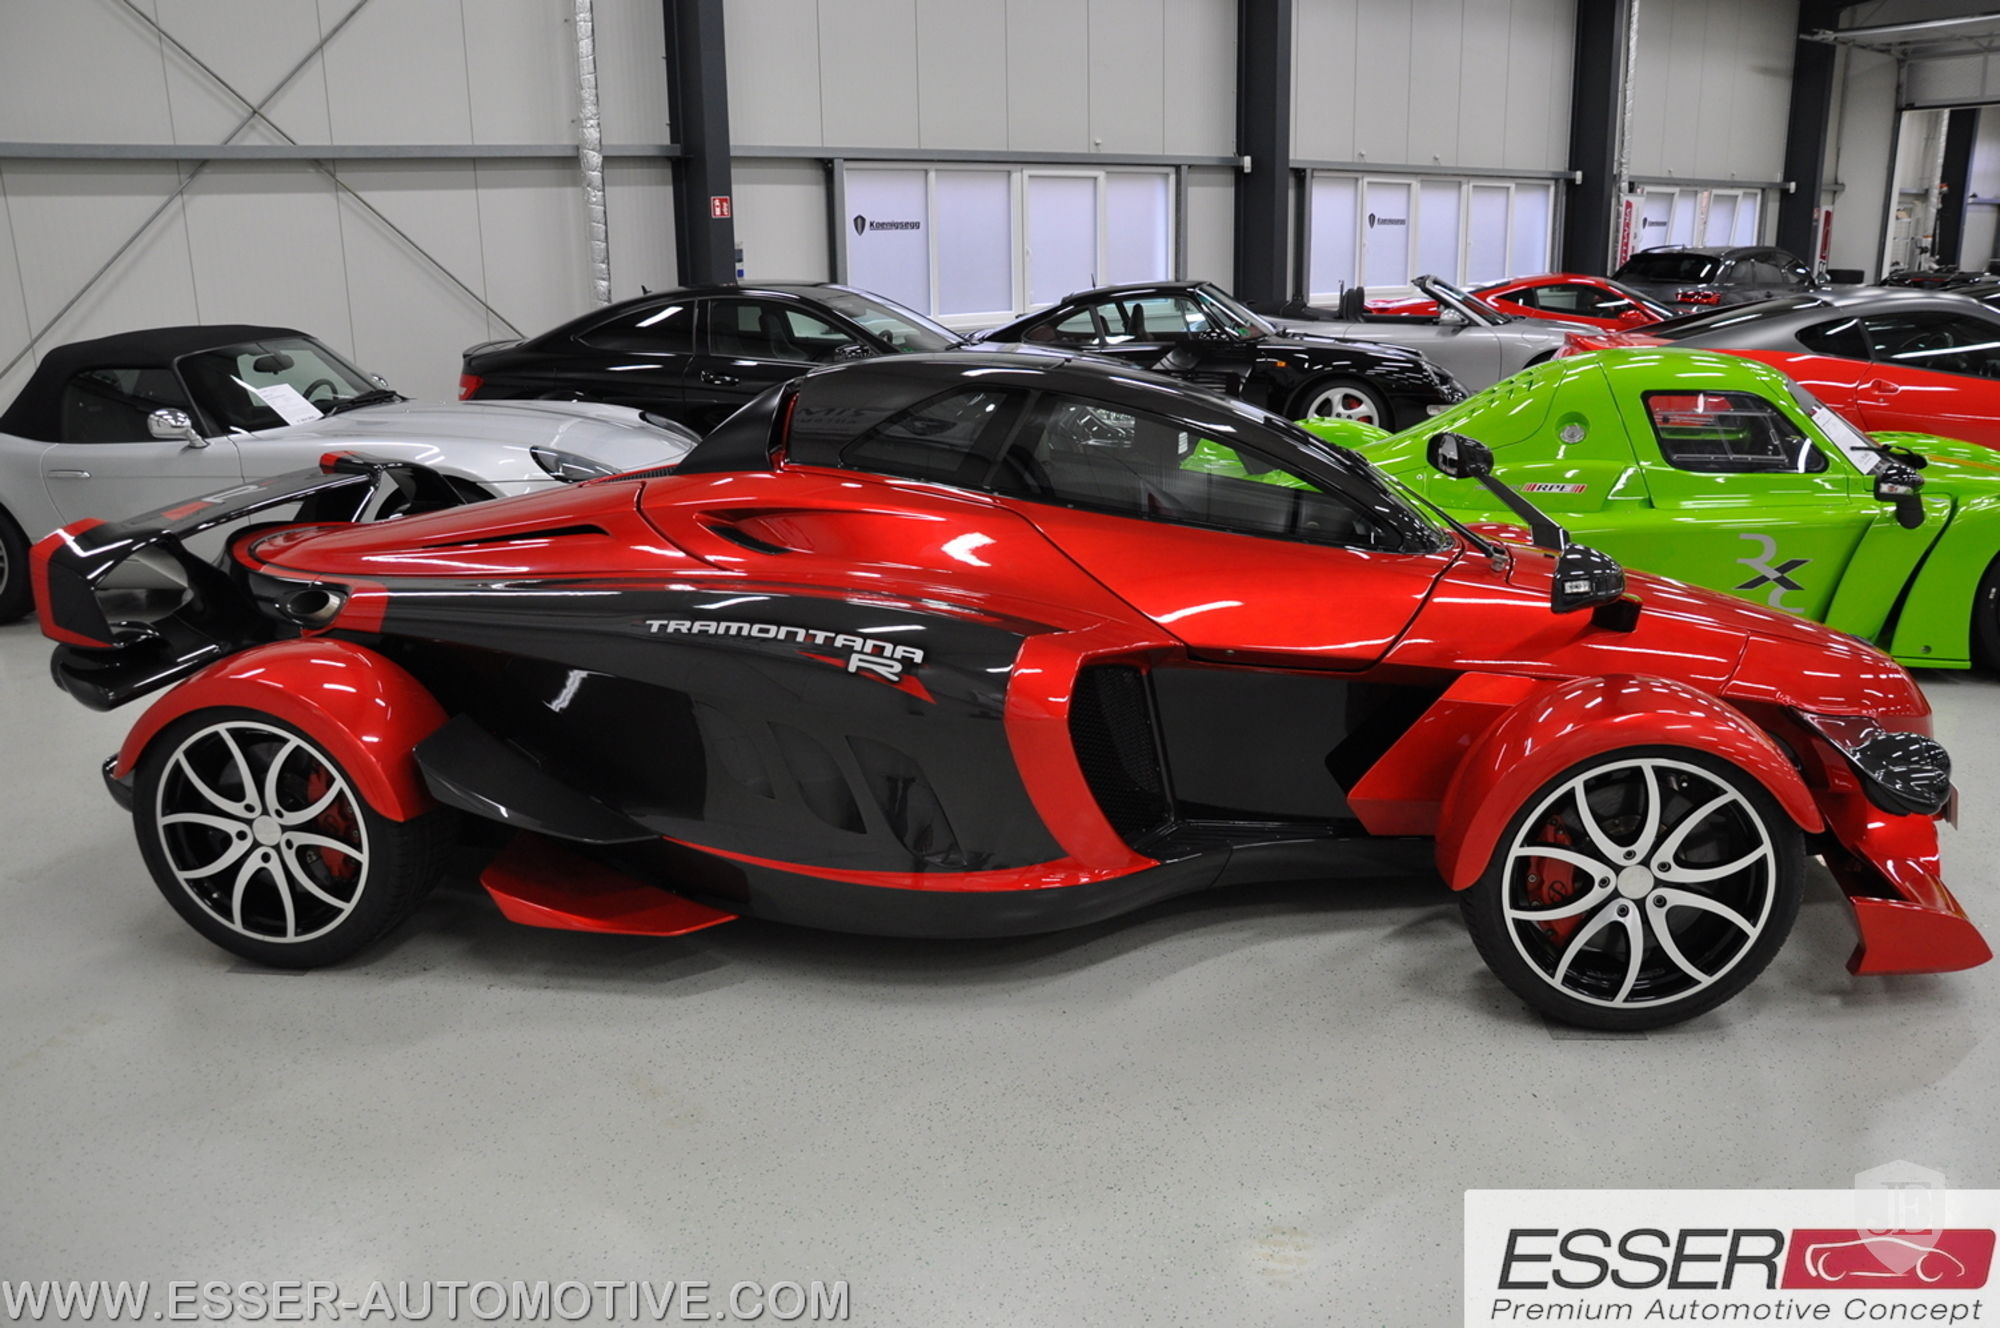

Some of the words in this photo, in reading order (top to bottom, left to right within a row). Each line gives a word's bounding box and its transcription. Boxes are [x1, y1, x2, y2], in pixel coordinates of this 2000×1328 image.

[869, 221, 920, 231] Koenigsegg
[645, 620, 924, 663] TRAMONTANA
[848, 653, 903, 681] R
